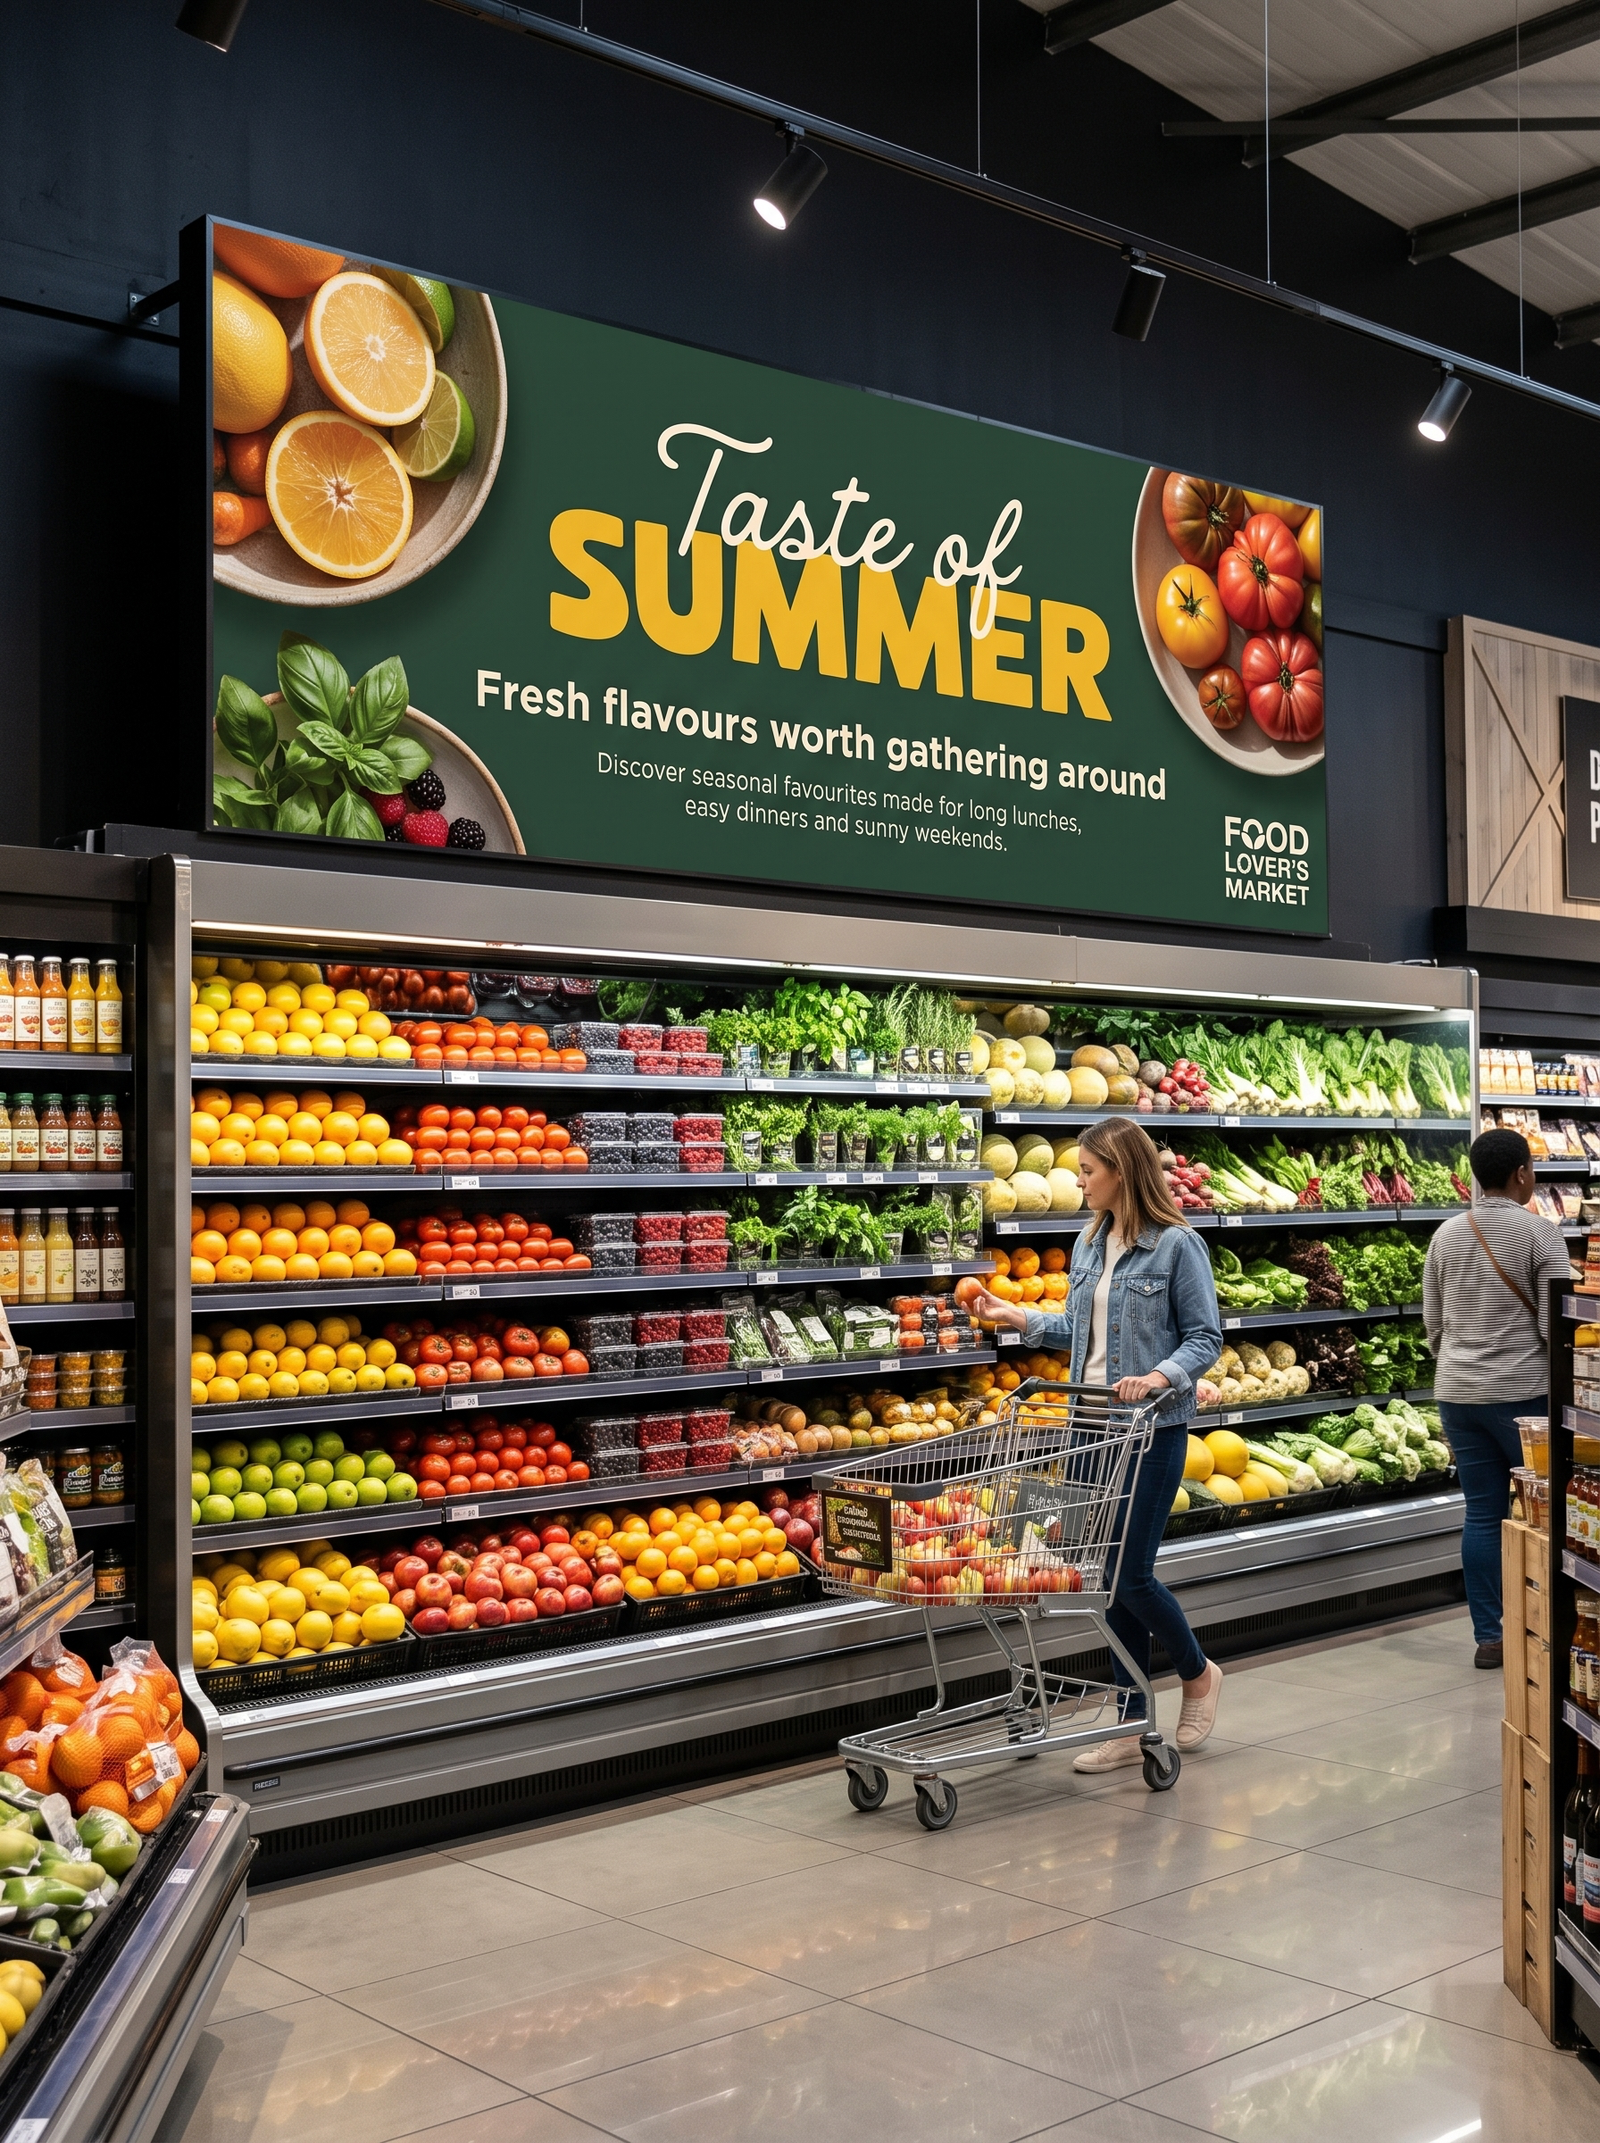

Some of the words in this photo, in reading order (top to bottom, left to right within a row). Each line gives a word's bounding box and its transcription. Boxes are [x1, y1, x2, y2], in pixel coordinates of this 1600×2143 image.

[657, 422, 915, 573] Taste
[932, 498, 1023, 640] of
[549, 508, 1113, 722] SUMMER
[477, 669, 590, 722] Fresh
[603, 686, 758, 745] flavours
[769, 719, 875, 761] worth
[886, 736, 1048, 791] gathering
[1058, 761, 1166, 801] around
[598, 751, 686, 783] Discover
[692, 768, 777, 795] seasonal
[783, 775, 877, 807] favourites
[883, 792, 934, 814] made
[938, 795, 964, 817] for
[969, 798, 1007, 827] long
[1013, 804, 1082, 836] lunches,
[685, 799, 730, 823] easy
[736, 800, 808, 829] dinners
[814, 812, 849, 833] and
[854, 819, 909, 844] sunny
[914, 825, 1007, 852] weekends.
[1224, 815, 1309, 856] FOOD
[1224, 851, 1310, 882] LOVER'S
[1225, 877, 1310, 906] MARKET
